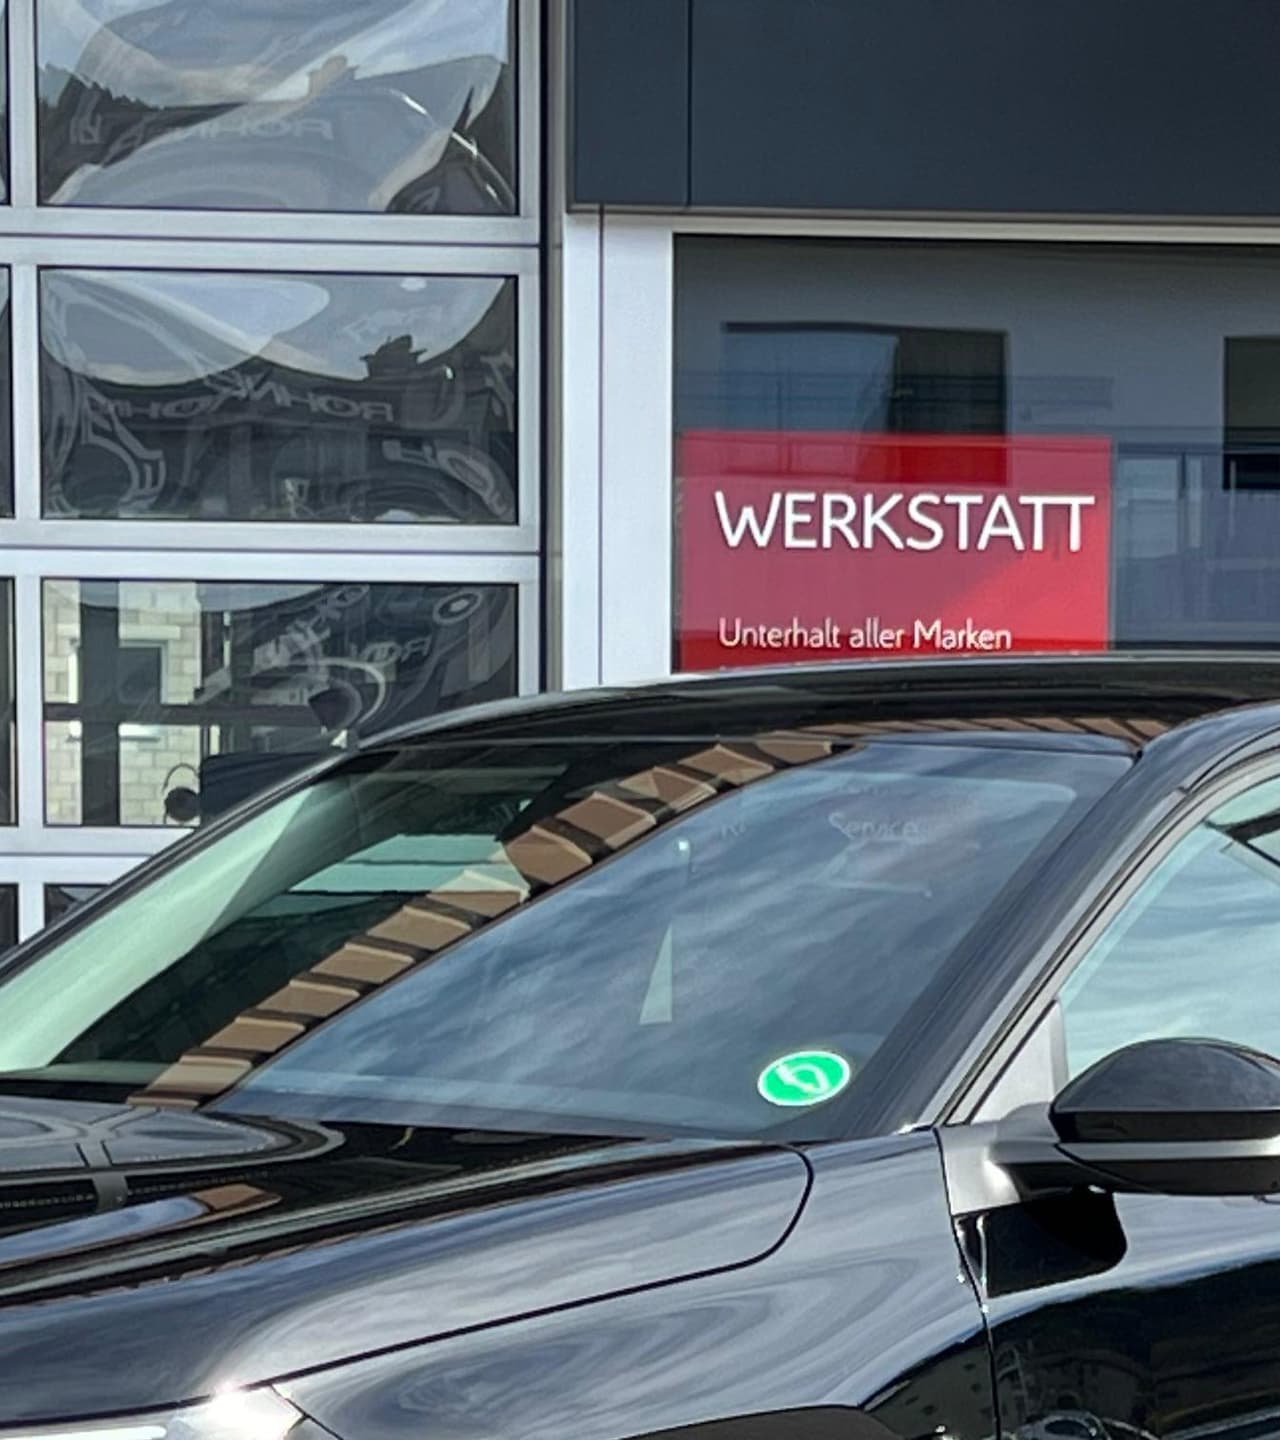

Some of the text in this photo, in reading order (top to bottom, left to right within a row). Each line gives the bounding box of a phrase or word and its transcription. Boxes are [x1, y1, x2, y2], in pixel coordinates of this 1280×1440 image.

[715, 490, 1095, 552] WERKSTATT
[719, 616, 1011, 650] Unterhalt aller Marken
